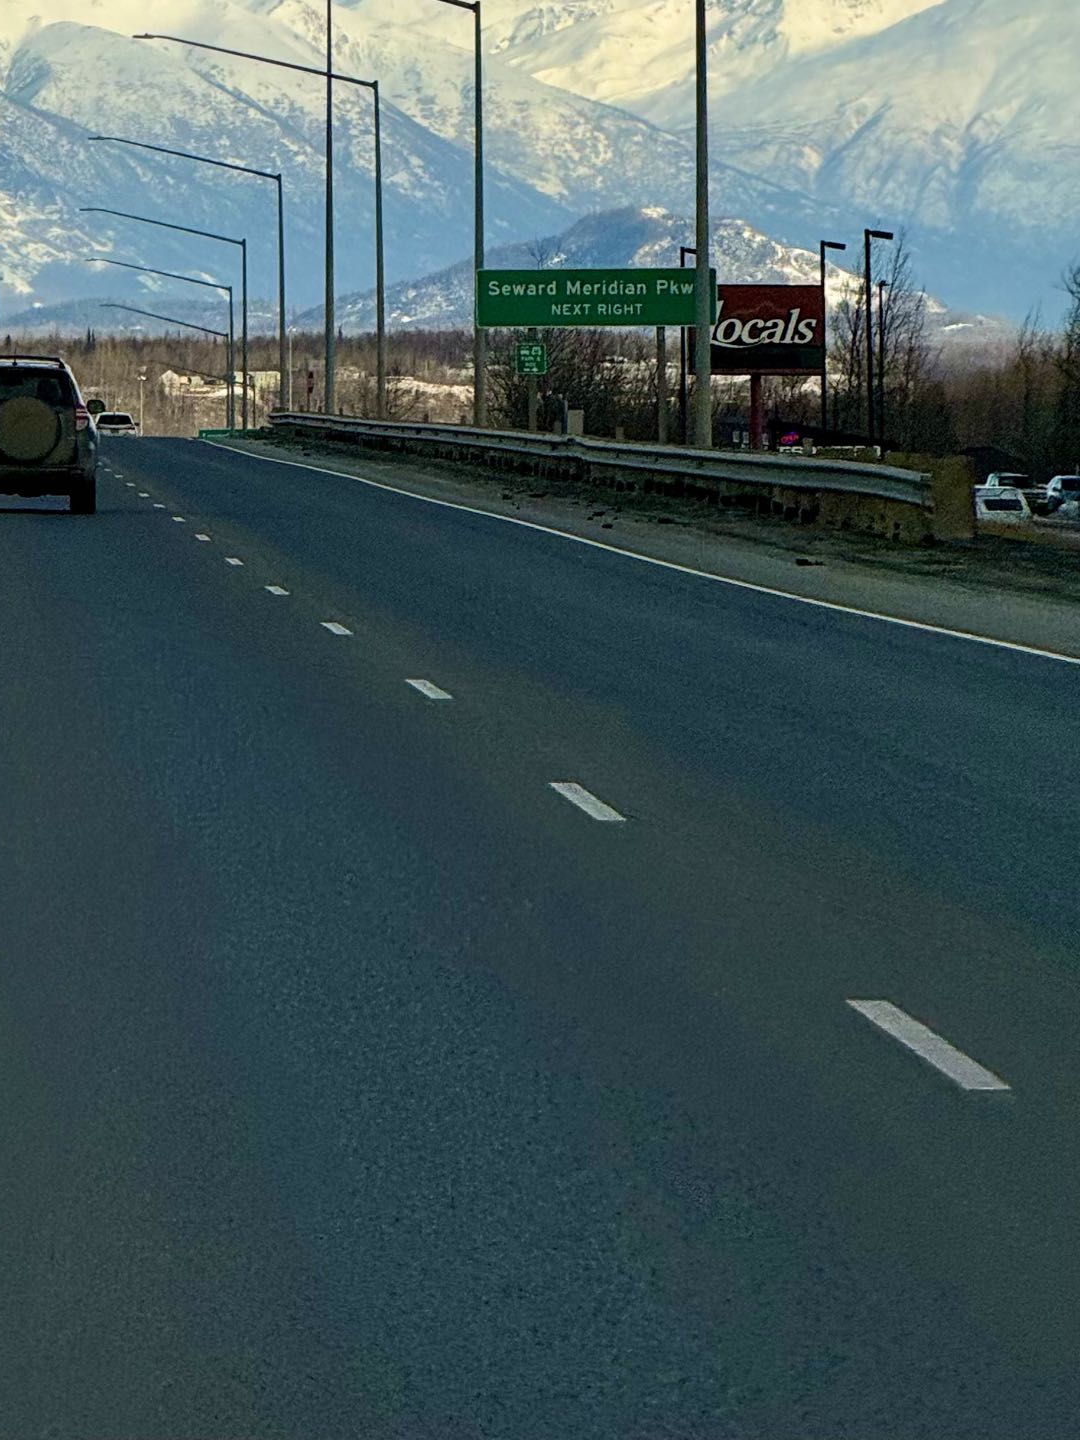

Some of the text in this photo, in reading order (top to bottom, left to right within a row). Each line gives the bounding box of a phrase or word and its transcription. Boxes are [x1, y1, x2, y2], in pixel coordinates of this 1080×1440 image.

[487, 279, 695, 296] Seward Meridian Pkw
[550, 303, 643, 316] NEXT RIGHT
